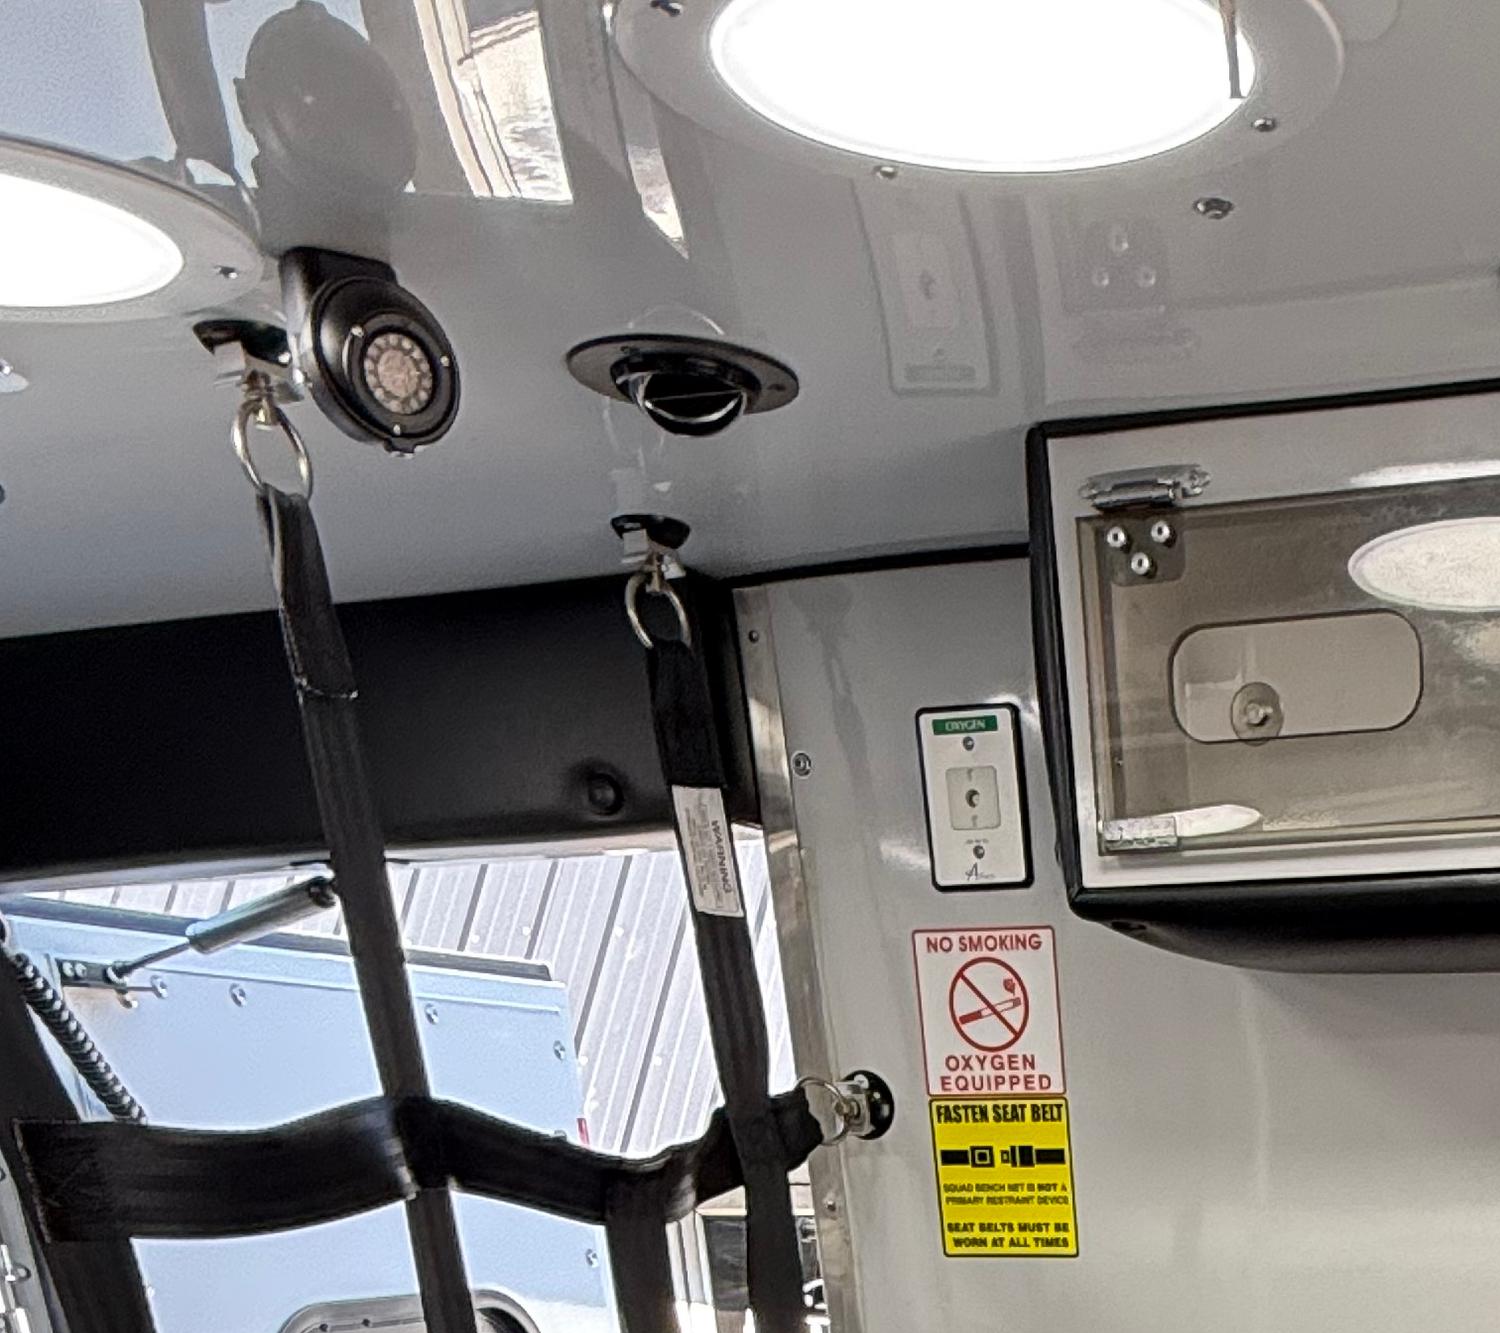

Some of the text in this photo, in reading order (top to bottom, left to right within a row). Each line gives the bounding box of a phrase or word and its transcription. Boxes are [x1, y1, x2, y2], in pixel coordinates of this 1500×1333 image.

[945, 719, 986, 731] OXYGEN
[711, 820, 732, 894] WARNING
[926, 933, 1042, 953] NO SMOKING
[945, 1054, 1035, 1071] OXYGEN
[940, 1074, 1051, 1091] EQUIPPED
[936, 1104, 1063, 1123] FASTEN SEAT BELT
[943, 1183, 973, 1193] SQUAD
[1037, 1183, 1057, 1192] NOT
[1061, 1183, 1067, 1192] A
[947, 1222, 1069, 1233] SEAT BELTS MUST BE
[953, 1237, 1069, 1247] WORN AT ALL TIMES
